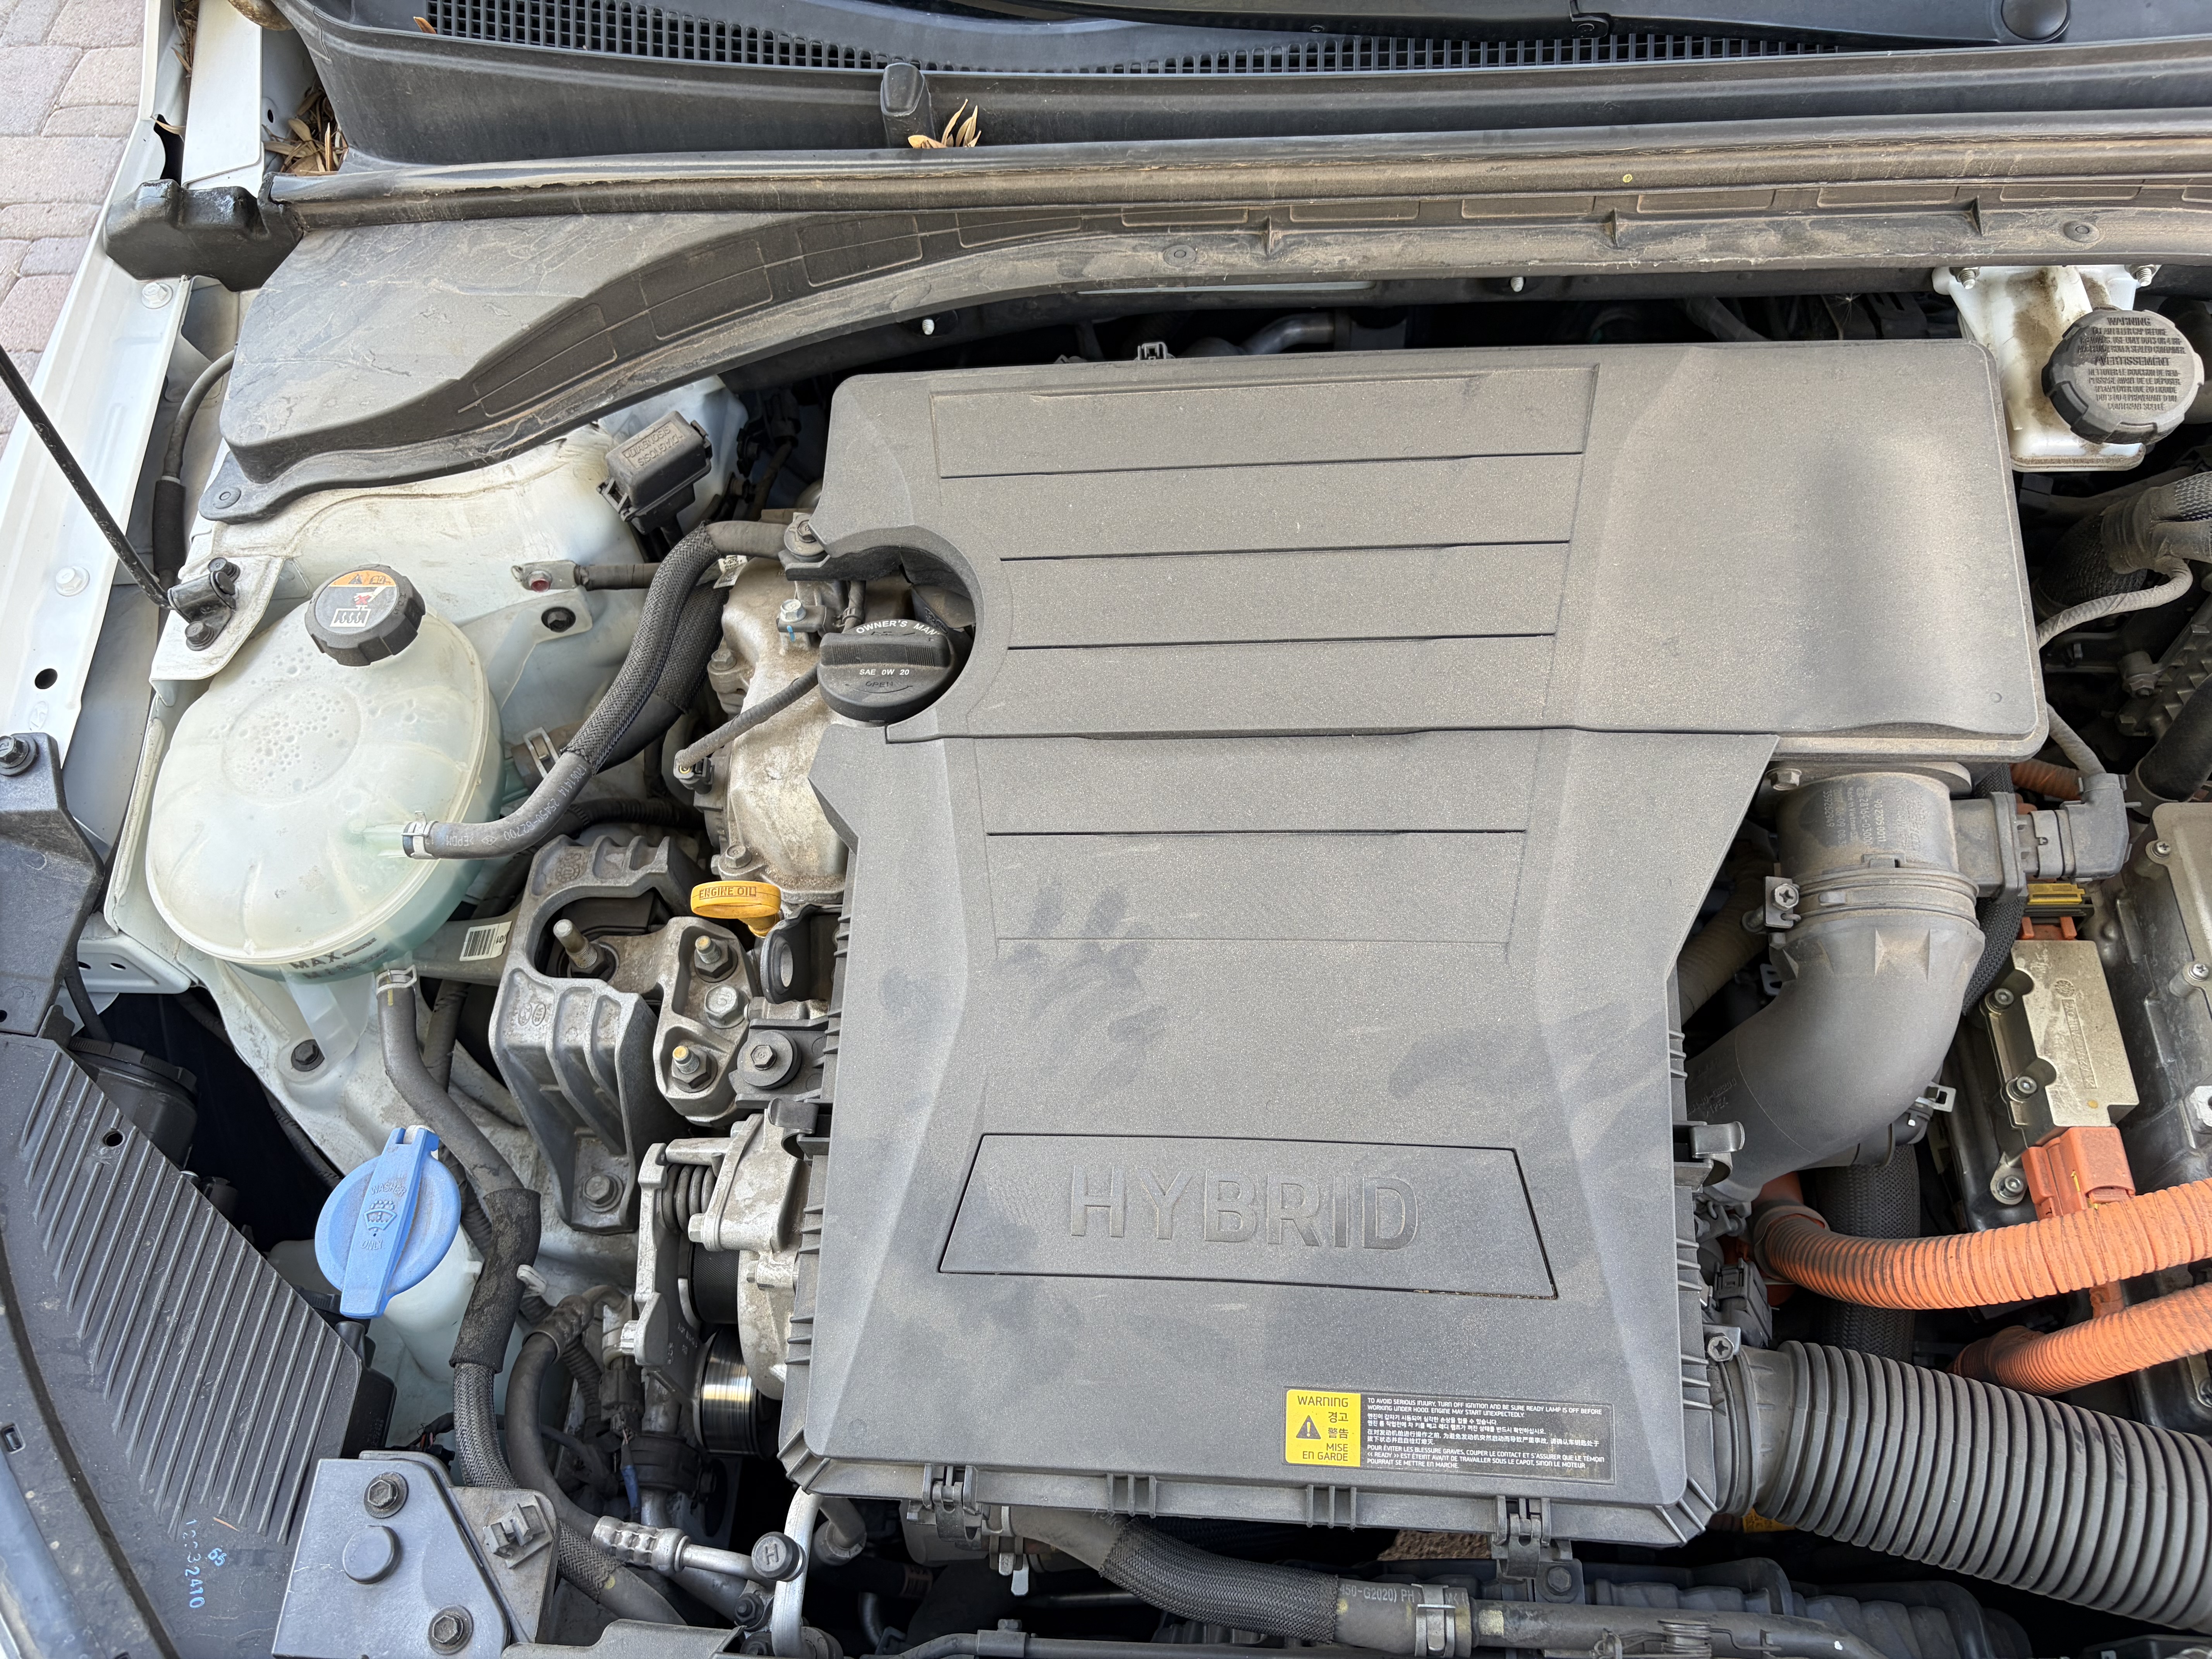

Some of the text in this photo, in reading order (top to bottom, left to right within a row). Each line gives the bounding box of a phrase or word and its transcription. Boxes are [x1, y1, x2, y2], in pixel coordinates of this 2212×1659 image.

[2107, 317, 2151, 326] WARNING
[2096, 356, 2170, 366] AVERTISSEMENT
[630, 426, 671, 457] DIAGNOSIS
[856, 620, 908, 633] OWNER'S
[504, 798, 560, 841] 25450-G2700
[699, 886, 756, 898] ENGINE OIL
[289, 952, 342, 969] MAX
[302, 963, 350, 979] MIN
[371, 1183, 406, 1197] WASHER
[1071, 1166, 1418, 1250] HYBRID
[361, 1240, 383, 1250] ONLY
[1297, 1396, 1348, 1407] WARNING
[1328, 1412, 1348, 1423] 경고
[1328, 1427, 1348, 1439] 警告
[1326, 1443, 1348, 1452] MISE
[1383, 1444, 1402, 1452] ÉVITER
[1582, 1454, 1604, 1462] TÉMOIN
[1303, 1451, 1348, 1461] EN GARDE
[765, 1543, 779, 1565] H
